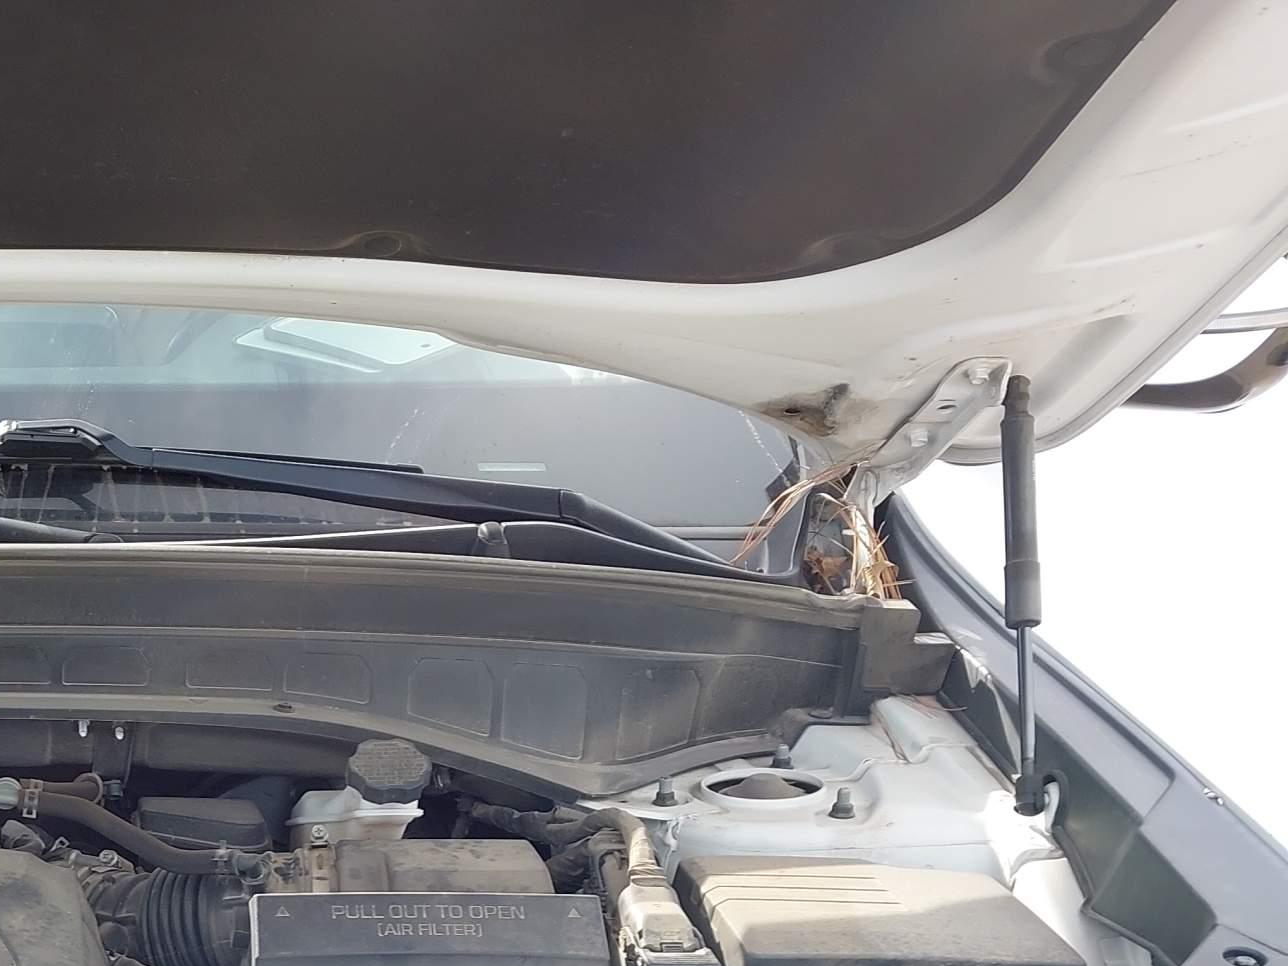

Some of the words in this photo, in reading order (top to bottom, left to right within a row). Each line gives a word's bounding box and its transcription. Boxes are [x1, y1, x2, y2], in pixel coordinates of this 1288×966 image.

[331, 904, 385, 920] PULL
[388, 904, 432, 919] OUT
[434, 904, 463, 919] TO
[468, 904, 526, 920] OPEN
